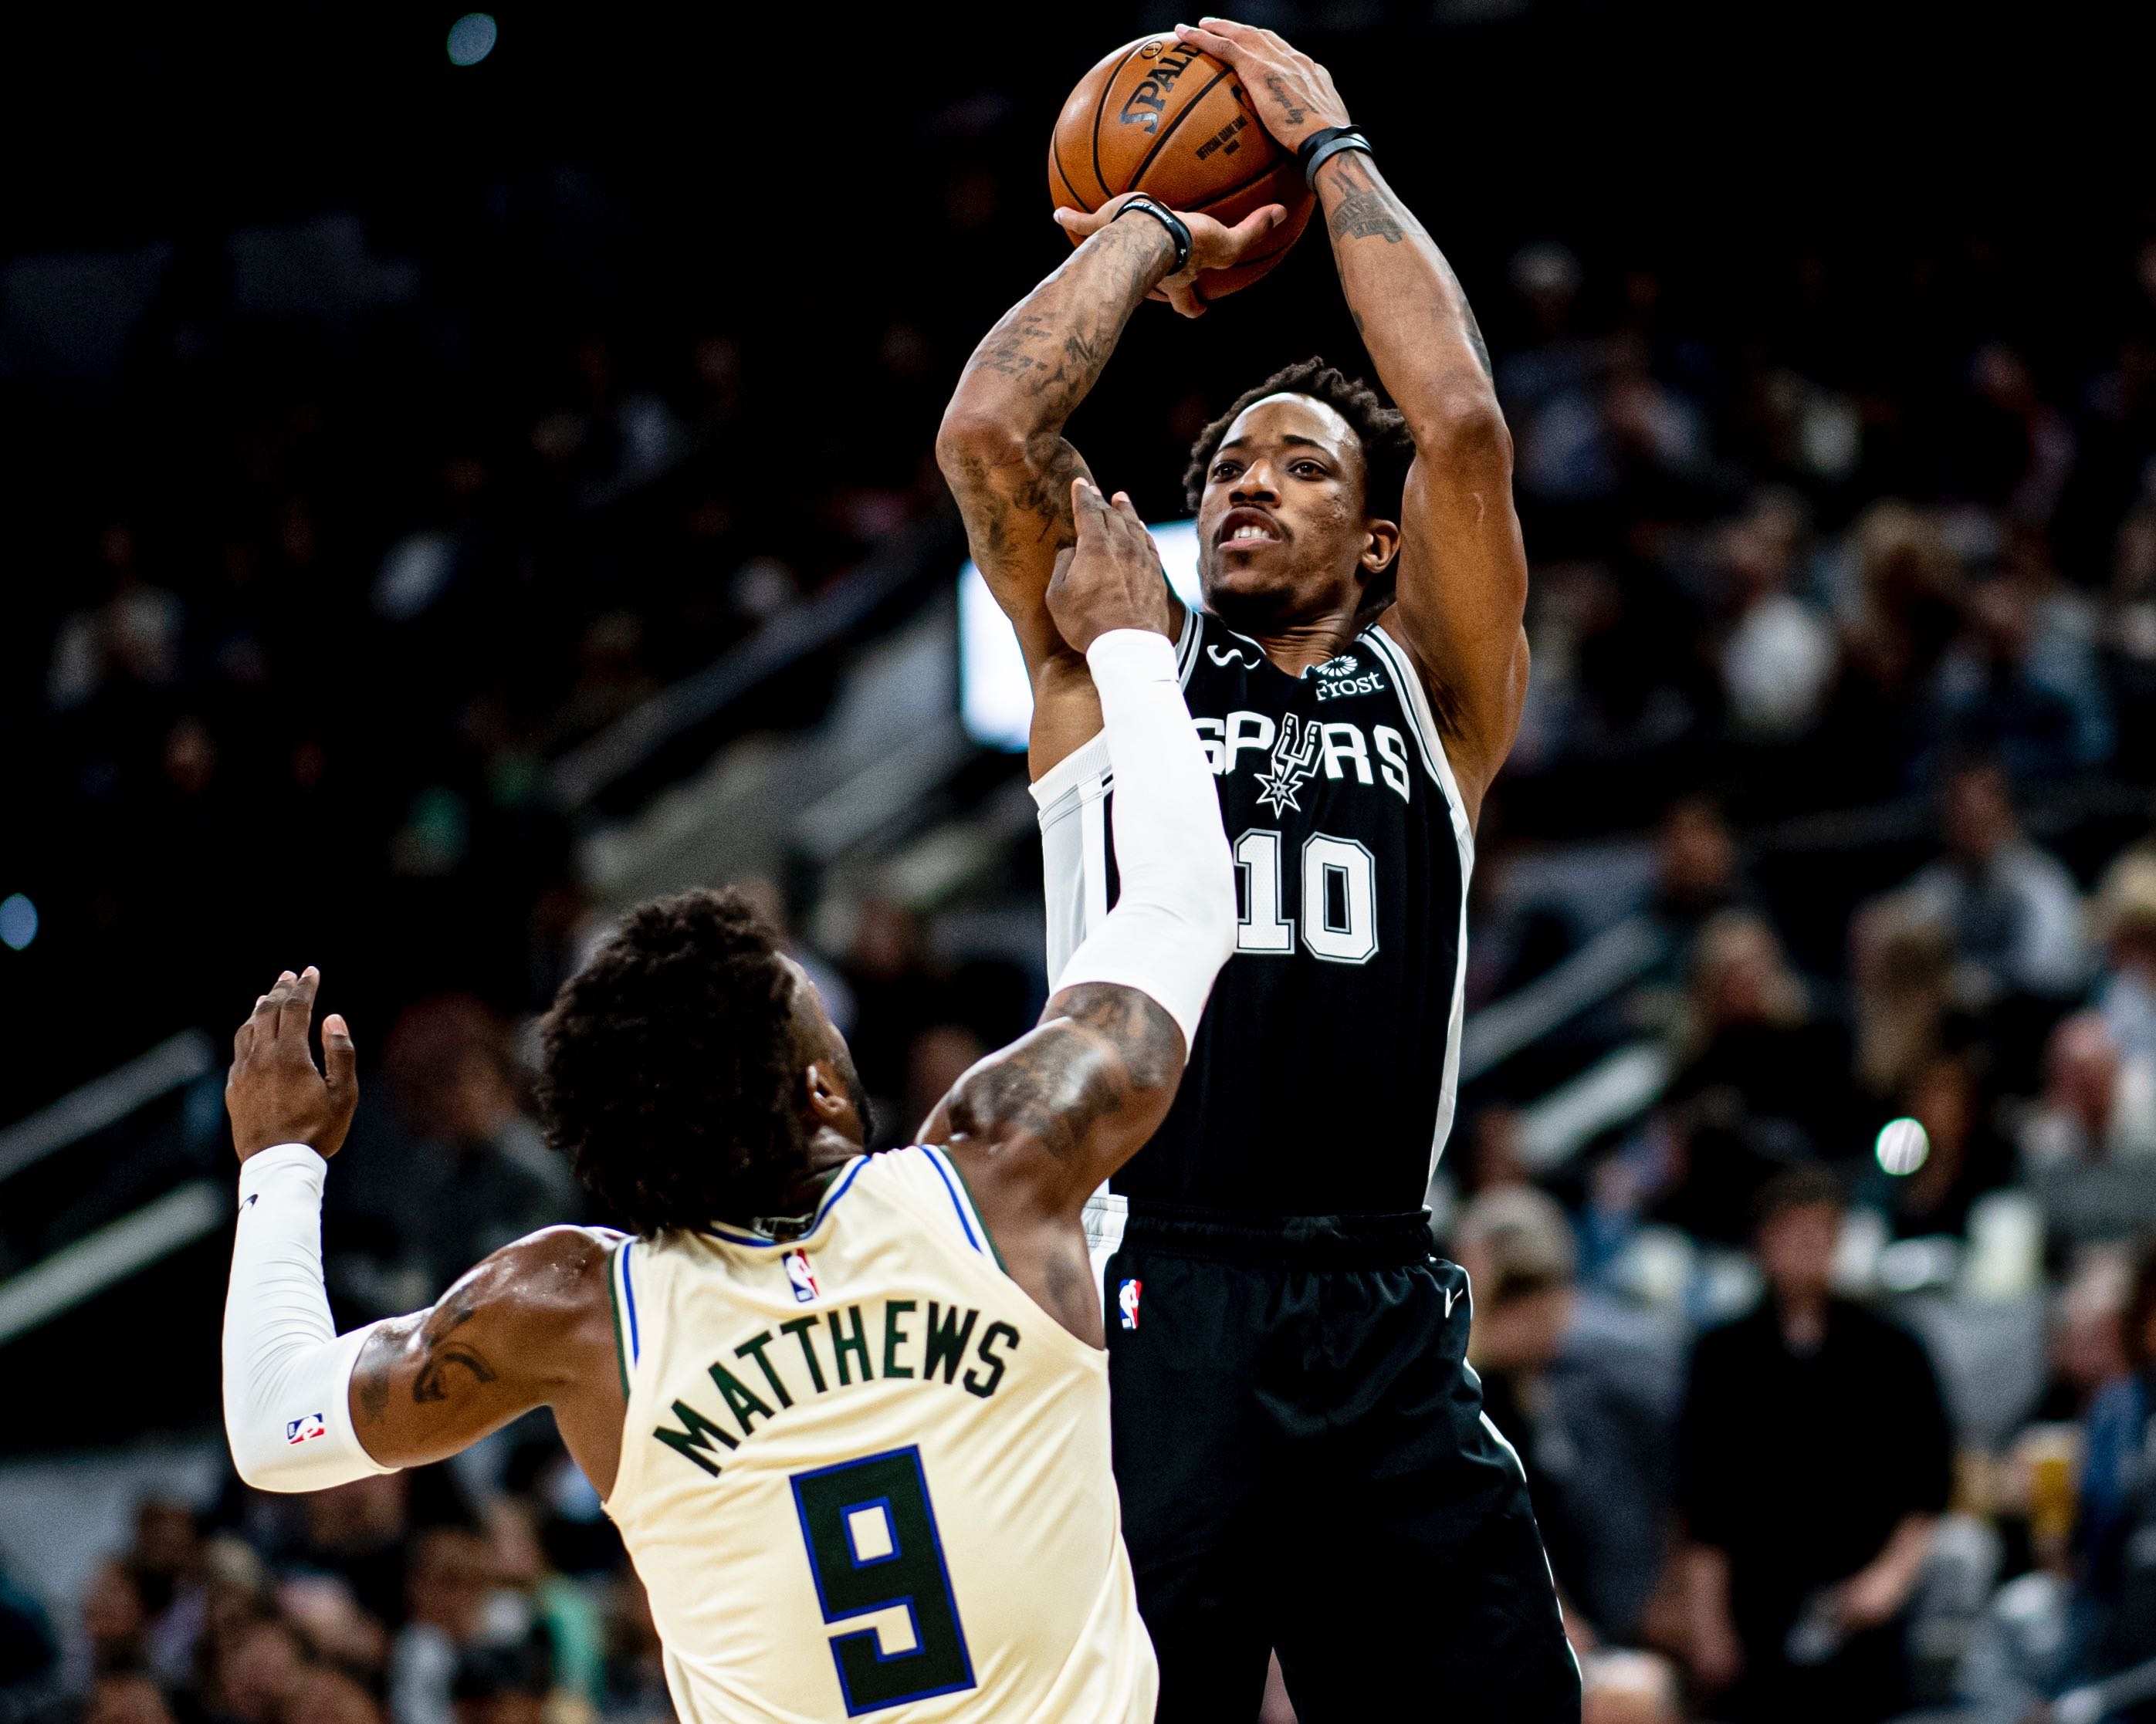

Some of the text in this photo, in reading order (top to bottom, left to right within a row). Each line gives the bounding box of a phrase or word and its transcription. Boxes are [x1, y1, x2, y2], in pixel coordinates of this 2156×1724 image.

[1119, 42, 1204, 135] SPALD
[1315, 671, 1385, 701] Frost
[1191, 711, 1410, 820] SPURS
[1234, 828, 1379, 965] 10
[652, 1300, 1020, 1478] MATTHEWS
[789, 1444, 978, 1719] 9
